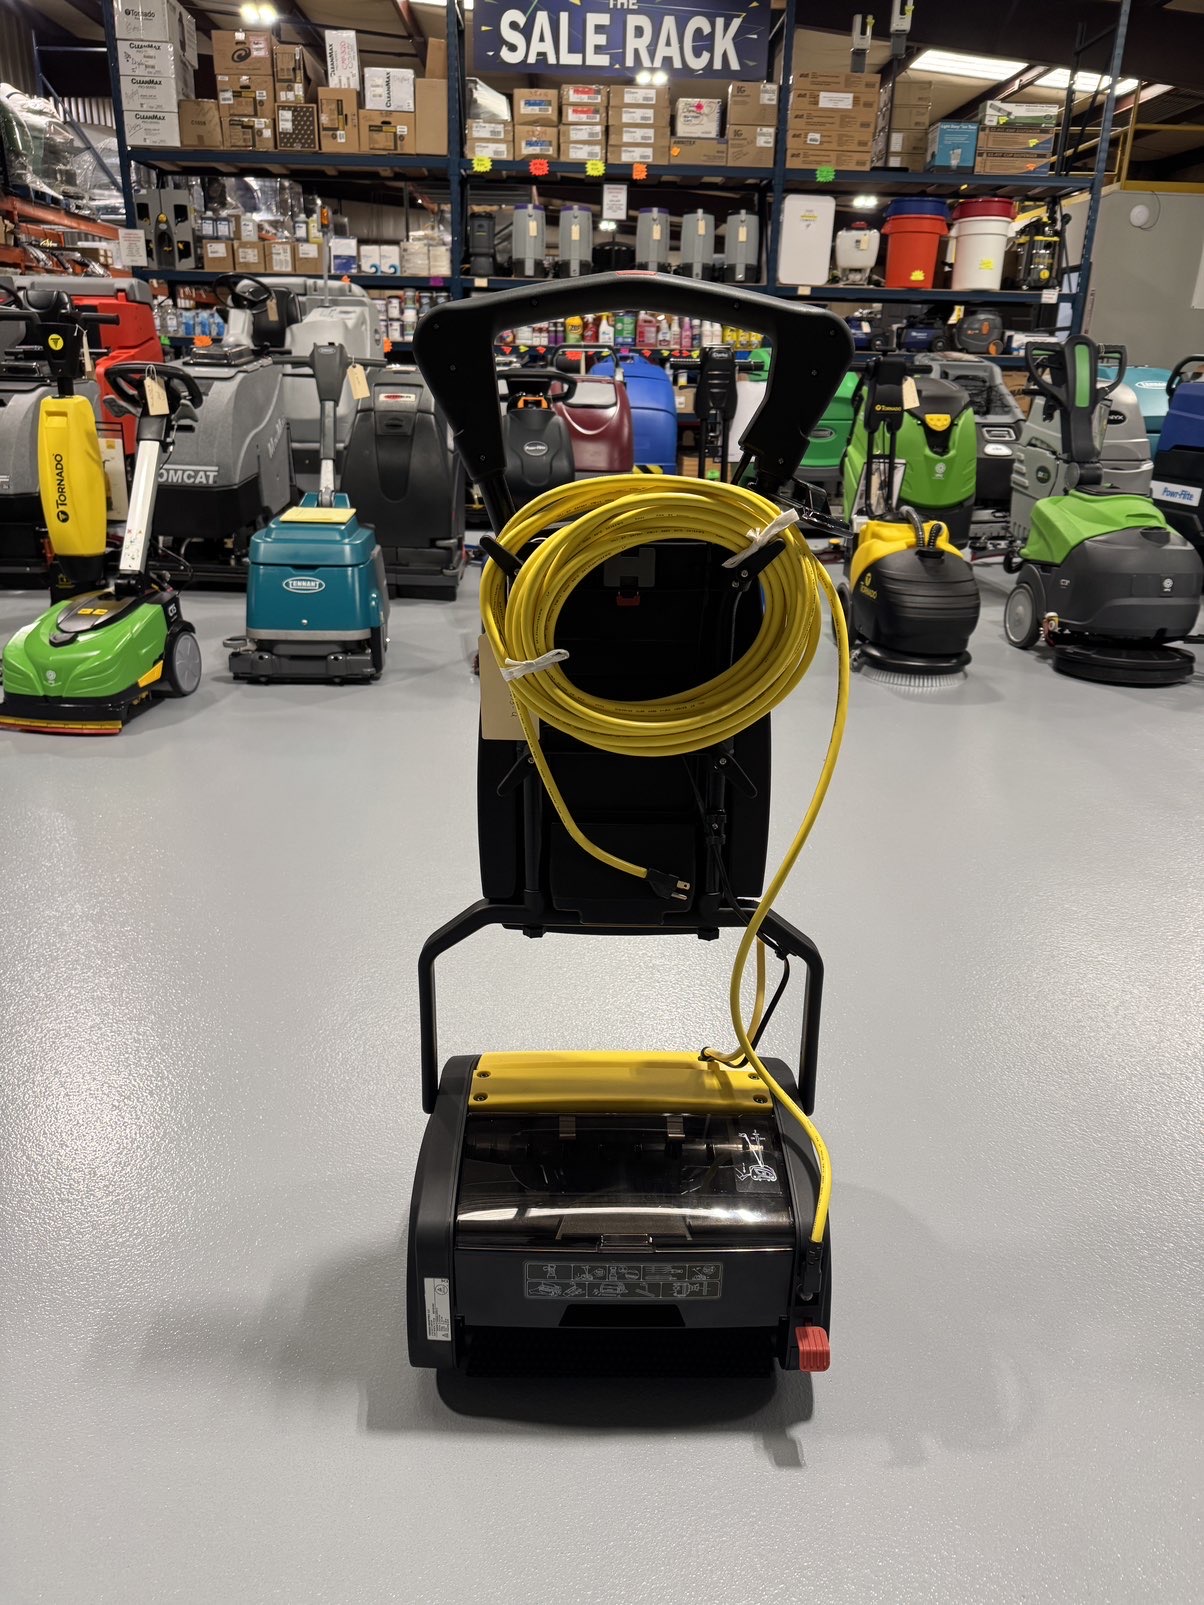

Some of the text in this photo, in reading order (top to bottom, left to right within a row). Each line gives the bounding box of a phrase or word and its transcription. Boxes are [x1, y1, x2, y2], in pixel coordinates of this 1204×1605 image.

[609, 0, 639, 9] THE
[499, 9, 743, 71] SALE RACK
[131, 78, 162, 86] CLEANMAX
[134, 113, 166, 121] CLEANMAX
[56, 454, 68, 509] TORNADO
[157, 470, 218, 485] OMCAT
[289, 580, 320, 589] TENNANT
